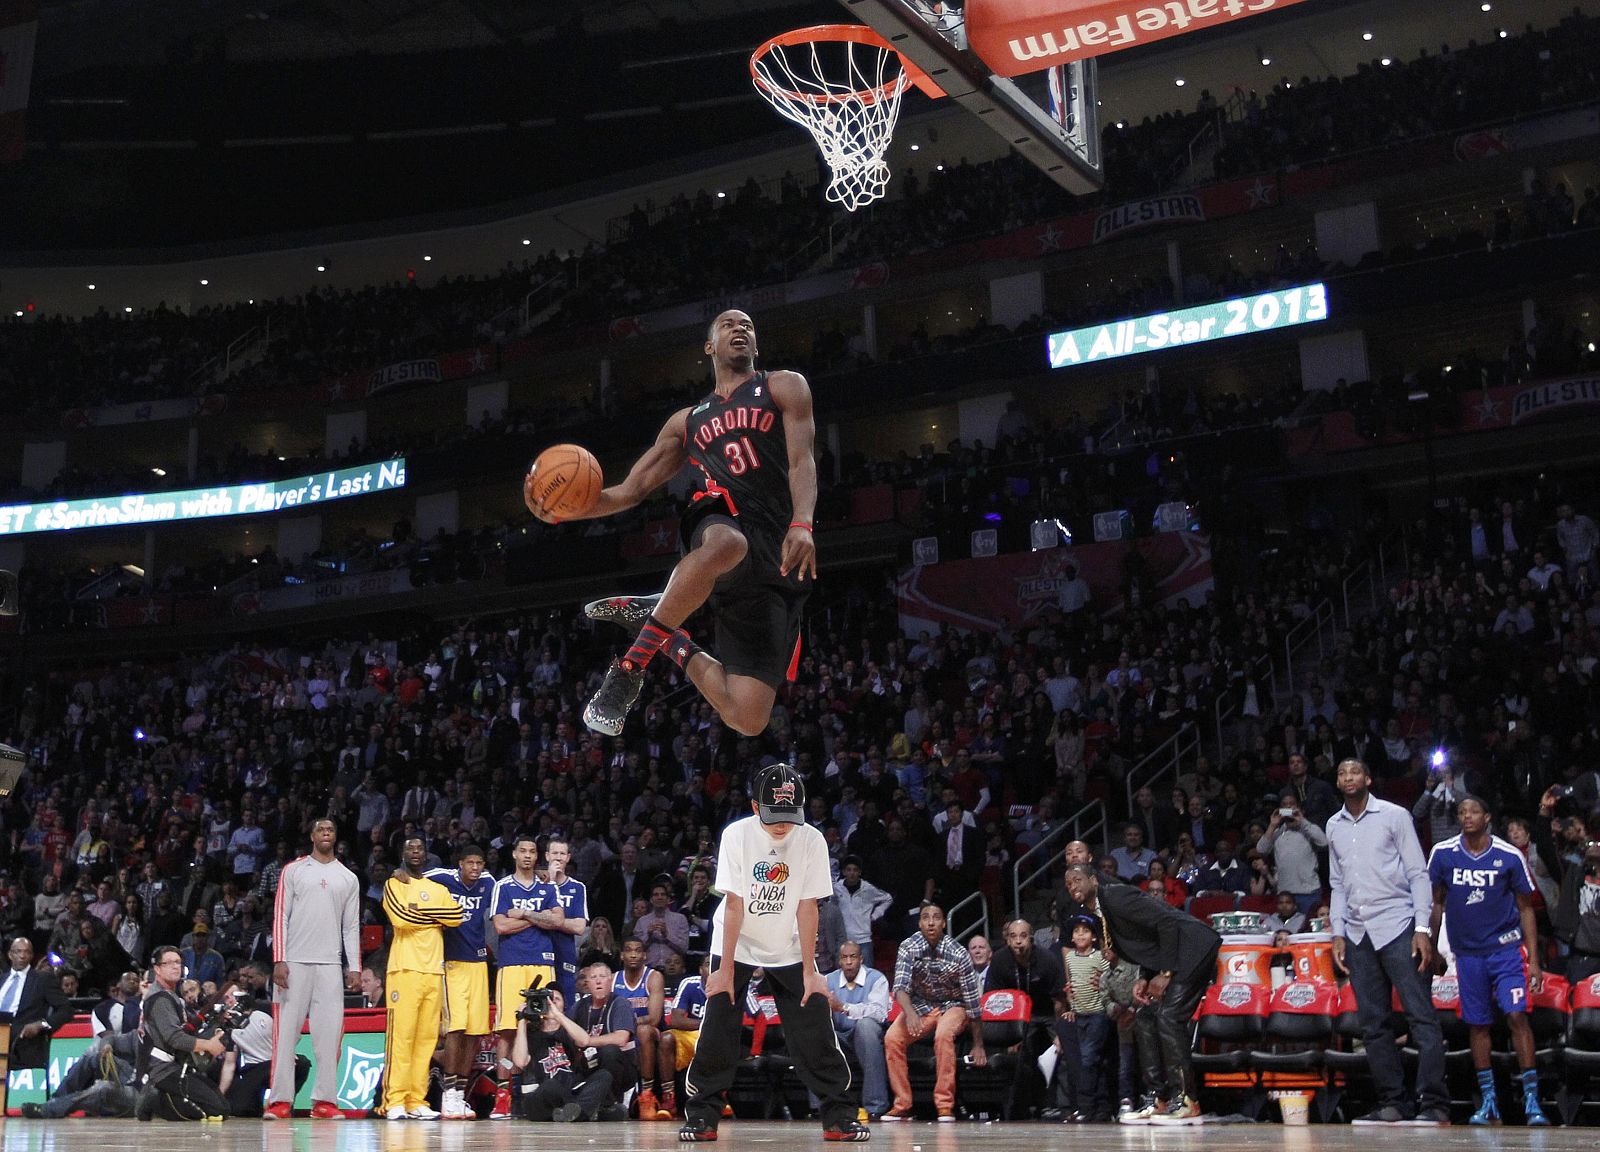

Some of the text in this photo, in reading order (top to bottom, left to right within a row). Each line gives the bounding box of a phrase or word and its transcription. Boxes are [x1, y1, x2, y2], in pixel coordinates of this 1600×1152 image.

[1095, 197, 1201, 240] ALL-STAR
[1087, 316, 1215, 356] All-Star
[1224, 283, 1326, 335] 2013
[693, 406, 775, 451] TORONTO
[723, 435, 760, 477] 31
[35, 496, 176, 530] #SpriteSlam
[181, 488, 232, 518] with
[238, 477, 321, 512] Player's
[325, 472, 372, 499] Last
[1452, 868, 1499, 887] EAST
[512, 897, 545, 911] EAST
[749, 900, 784, 914] Cares
[758, 885, 786, 901] NBA
[1510, 988, 1524, 1005] P
